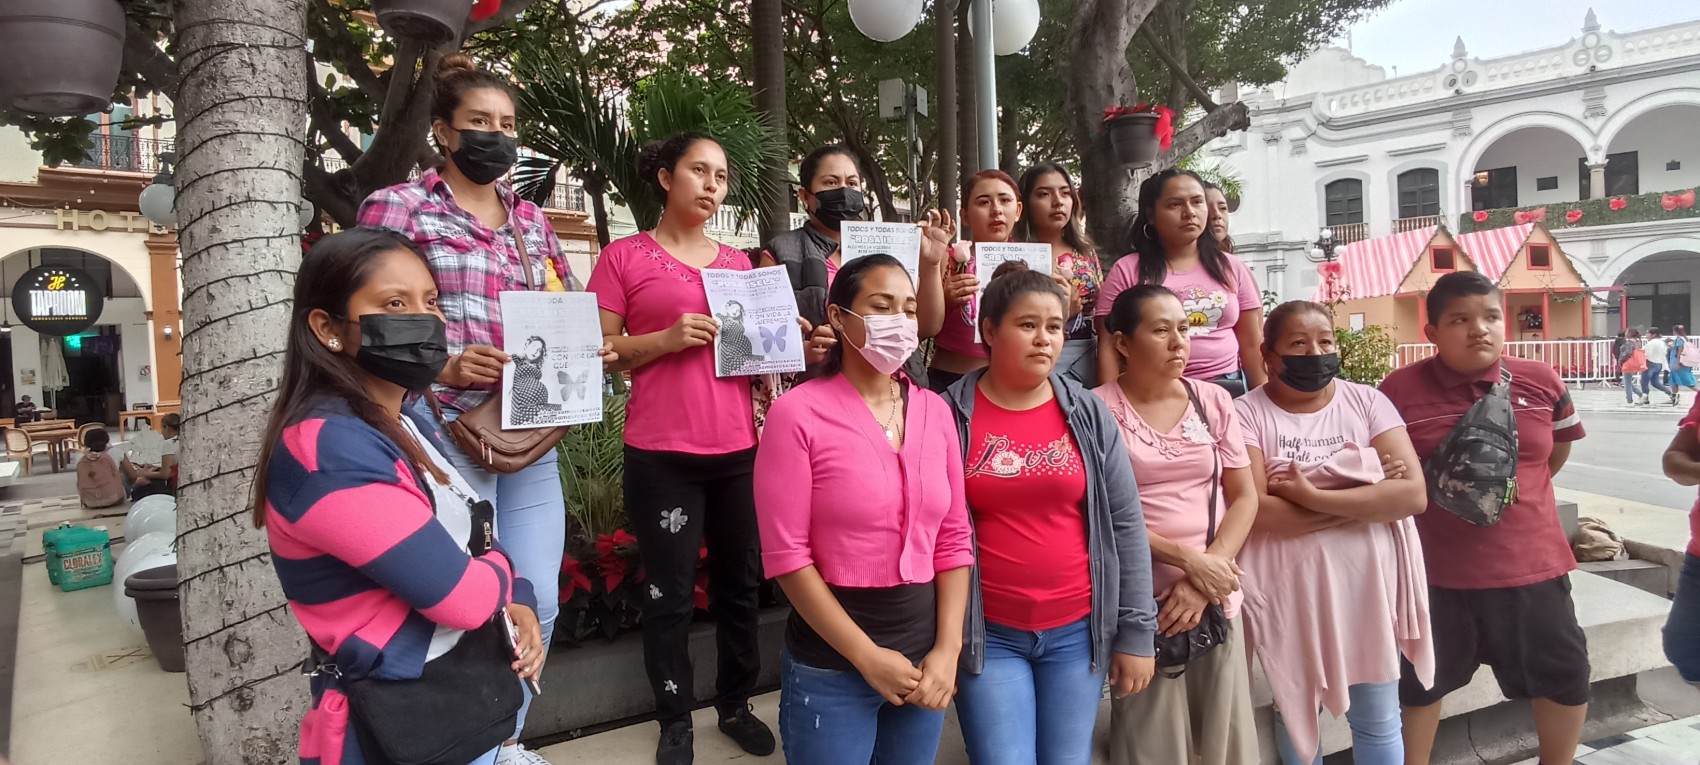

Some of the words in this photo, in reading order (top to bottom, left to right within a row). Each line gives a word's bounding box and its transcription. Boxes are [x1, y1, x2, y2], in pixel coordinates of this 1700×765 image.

[55, 208, 178, 234] HOT
[758, 269, 782, 277] SOMOS
[29, 290, 87, 316] TAPROOM
[1279, 434, 1302, 452] Half
[1304, 435, 1348, 447] human.
[1287, 450, 1311, 462] Half
